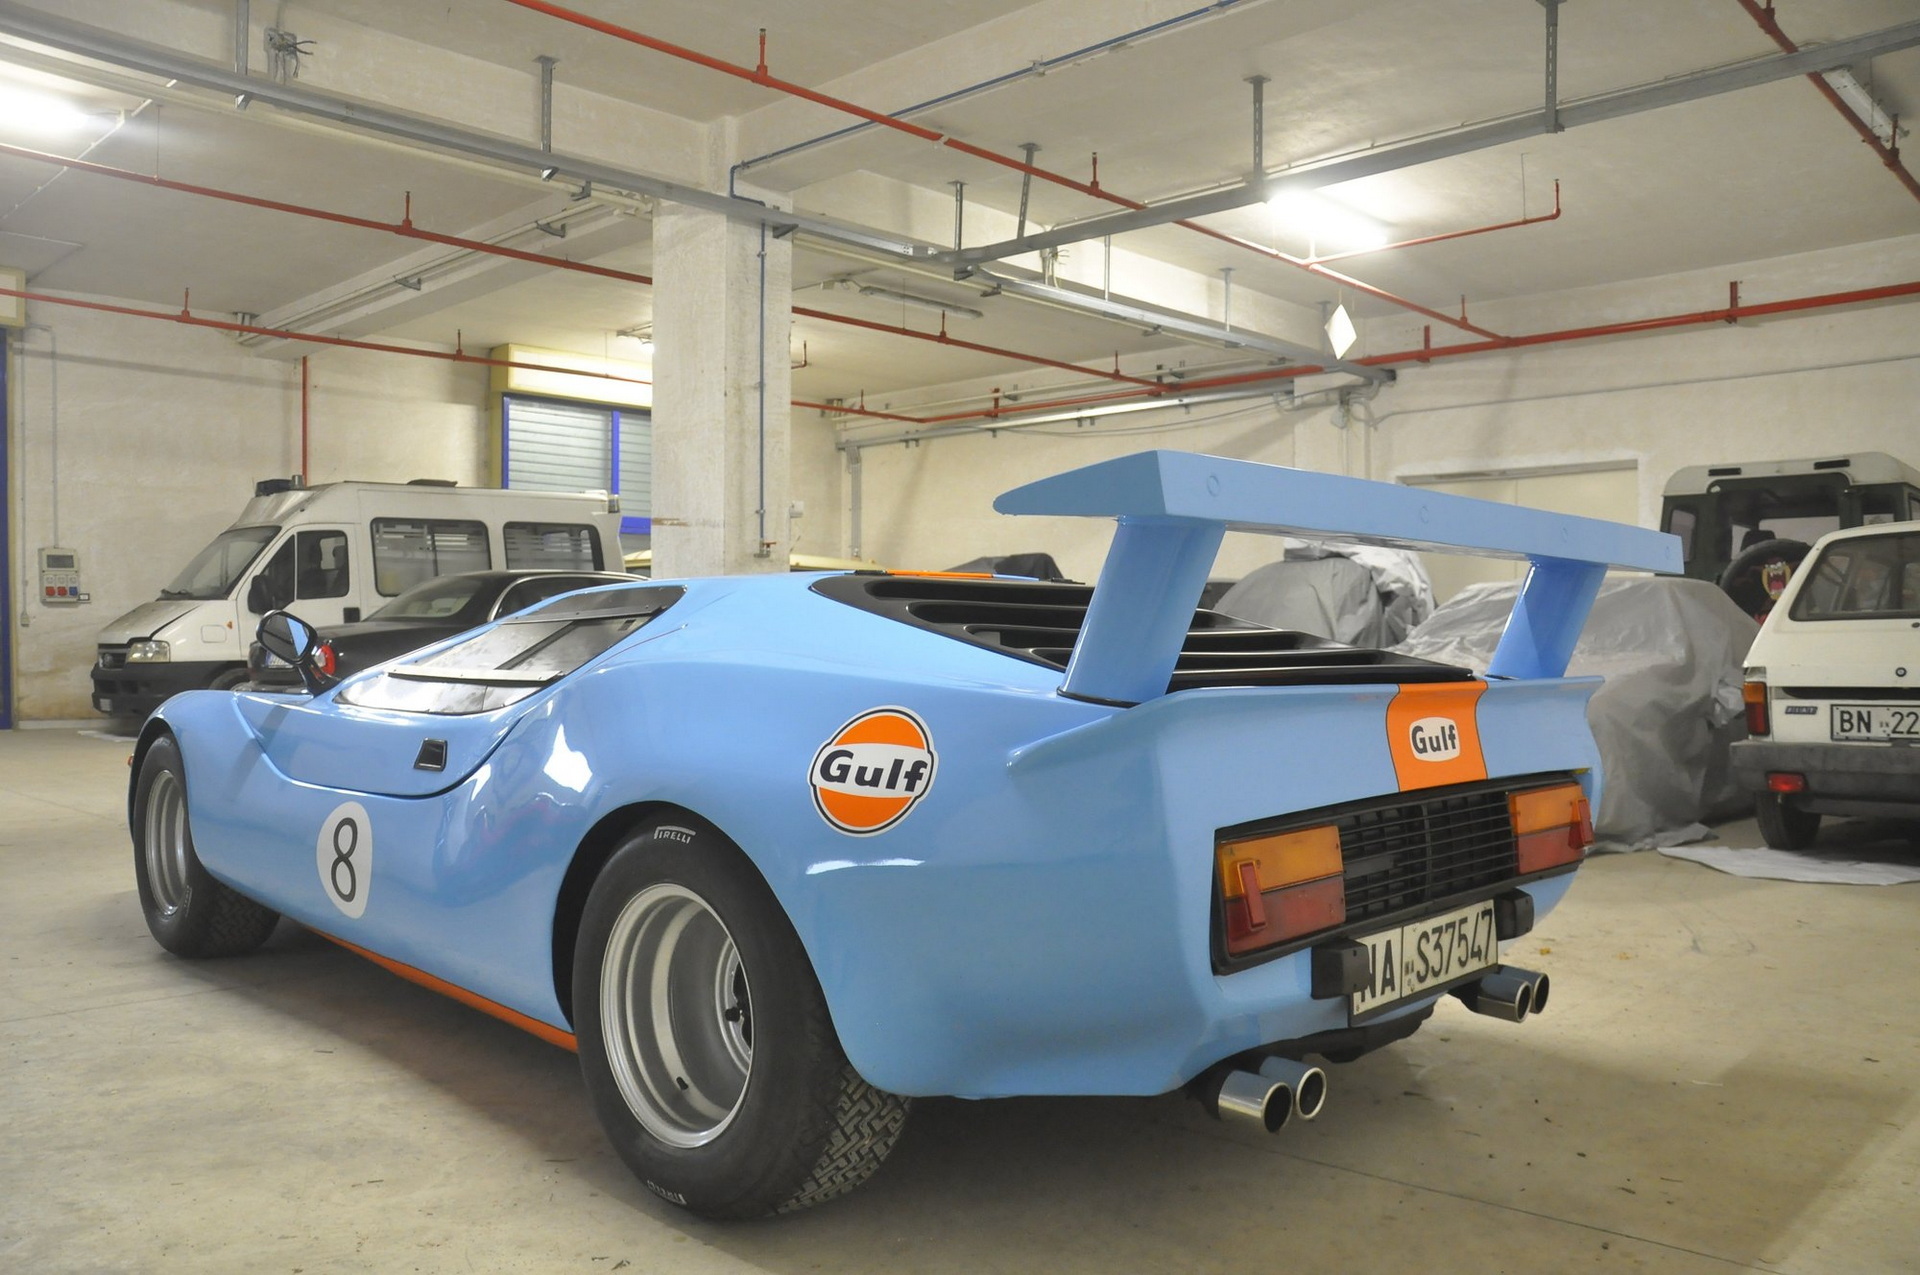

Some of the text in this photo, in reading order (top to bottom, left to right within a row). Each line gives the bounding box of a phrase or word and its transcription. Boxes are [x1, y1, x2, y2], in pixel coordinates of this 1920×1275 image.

[1411, 724, 1456, 754] Gulf
[1840, 710, 1919, 734] BN 22
[820, 749, 928, 792] Gulf
[653, 825, 696, 844] PIRELLI
[331, 817, 358, 903] 8
[1417, 908, 1493, 983] S37547
